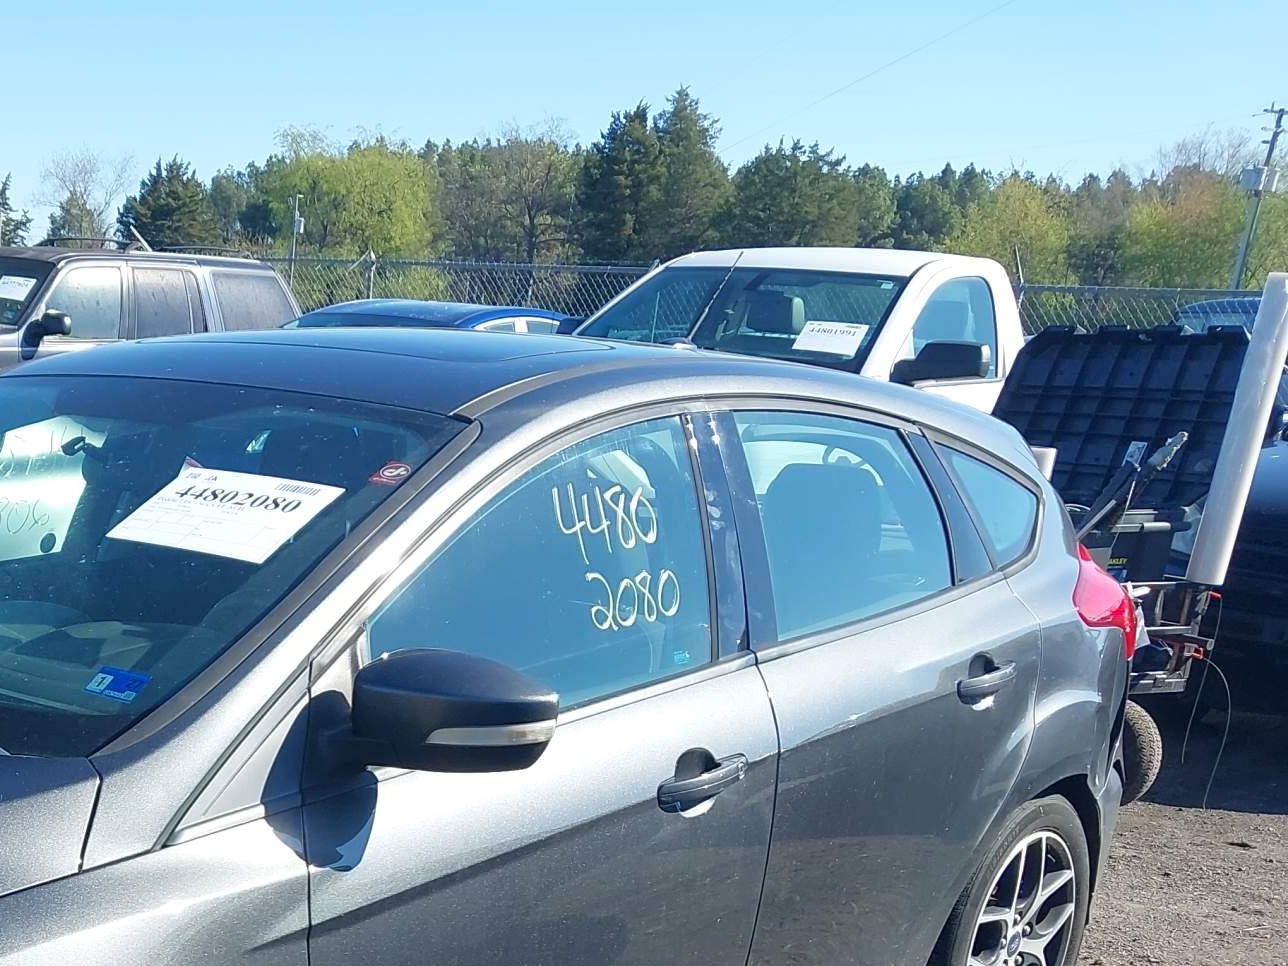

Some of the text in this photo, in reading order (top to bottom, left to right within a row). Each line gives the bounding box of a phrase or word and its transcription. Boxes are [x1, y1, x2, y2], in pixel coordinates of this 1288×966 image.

[175, 484, 302, 514] 44802080
[551, 482, 658, 565] 4480
[584, 569, 680, 632] 2080
